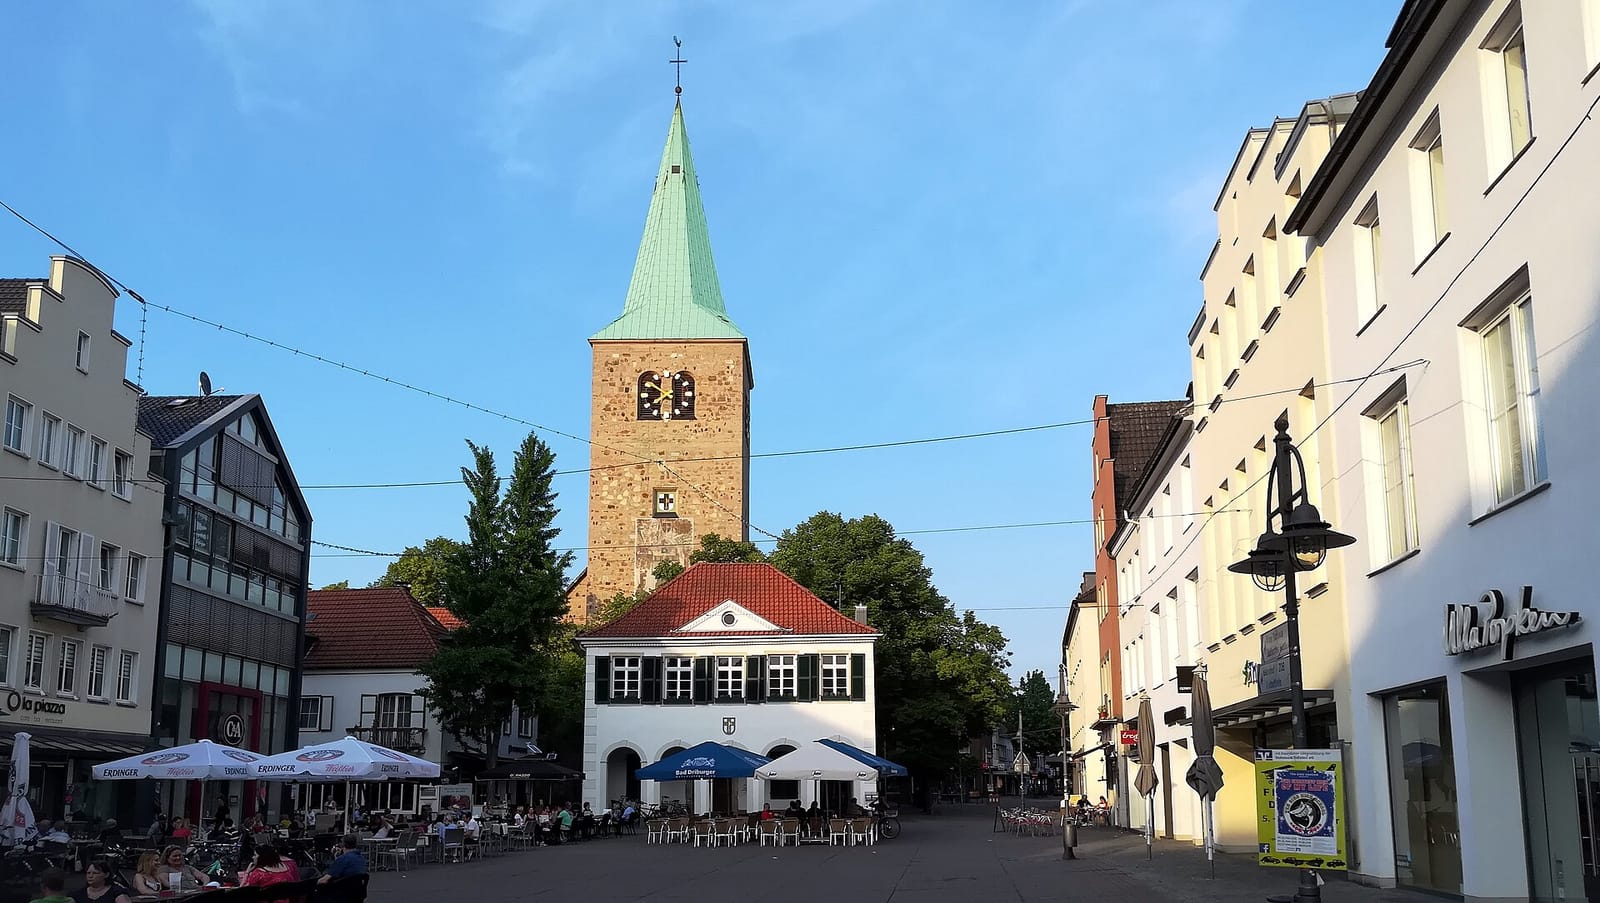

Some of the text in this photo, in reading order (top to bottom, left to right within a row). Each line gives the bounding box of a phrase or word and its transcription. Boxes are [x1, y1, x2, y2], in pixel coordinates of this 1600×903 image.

[1444, 585, 1584, 661] Ulla Popken
[226, 720, 240, 737] C&A
[103, 768, 138, 777] ERDINGER
[258, 764, 296, 773] ERDINGER
